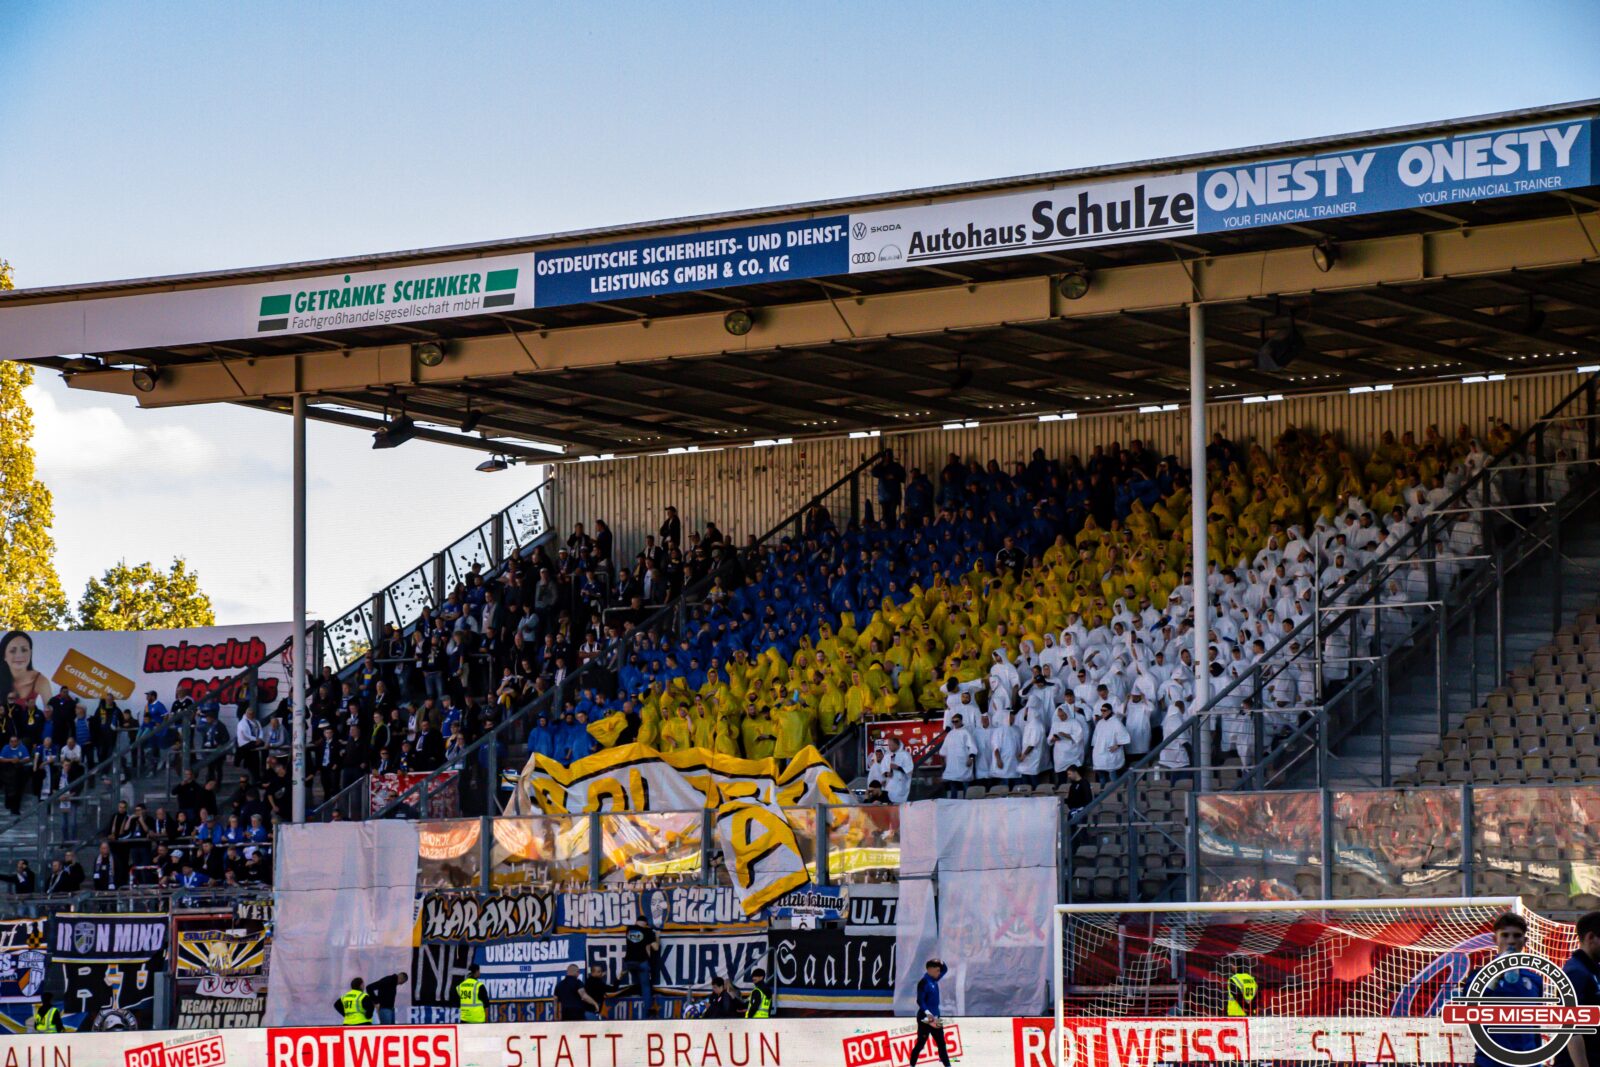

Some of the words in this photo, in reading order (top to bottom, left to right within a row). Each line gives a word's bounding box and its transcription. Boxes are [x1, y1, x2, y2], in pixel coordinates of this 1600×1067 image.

[1397, 124, 1583, 187] ONESTY
[1203, 152, 1376, 211] ONESTY
[1417, 190, 1448, 204] YOUR
[1451, 183, 1511, 201] FINANCIAL
[1514, 175, 1562, 192] TRAINER
[908, 222, 1027, 255] Autohaus
[1031, 184, 1195, 241] Schulze
[1222, 214, 1251, 228] YOUR
[1254, 207, 1311, 225] FINANCIAL
[1312, 201, 1357, 218] TRAINER
[537, 248, 638, 276] OSTDEUTSCHE
[642, 237, 743, 264] SICHERHEITS-
[747, 231, 782, 250] UND
[786, 224, 847, 247] DIENST-
[392, 272, 482, 303] SCHENKER
[590, 268, 669, 294] LEISTUNGS
[674, 262, 718, 284] GMBH
[722, 261, 734, 278] &
[738, 257, 764, 276] CO.
[769, 254, 790, 273] KG
[291, 299, 450, 330] Fachgroßhandelsgesellschaft
[452, 297, 481, 311] mbH
[144, 636, 267, 673] Reiseclub
[90, 666, 110, 680] DAS
[423, 896, 553, 938] HARAKIRI
[851, 898, 897, 924] ULT
[113, 923, 165, 952] MIND
[485, 940, 569, 963] UNBEUGSAM
[181, 1000, 213, 1014] VEGAN
[128, 1046, 162, 1067] ROT
[167, 1041, 221, 1067] WEISS
[274, 1034, 340, 1067] ROT
[348, 1033, 450, 1067] WEISS
[506, 1034, 624, 1067] STATT
[647, 1032, 781, 1067] BRAUN
[847, 1035, 886, 1063] ROT
[1022, 1026, 1103, 1067] ROT
[1111, 1027, 1242, 1063] WEISS
[1311, 1030, 1462, 1063] STATT
